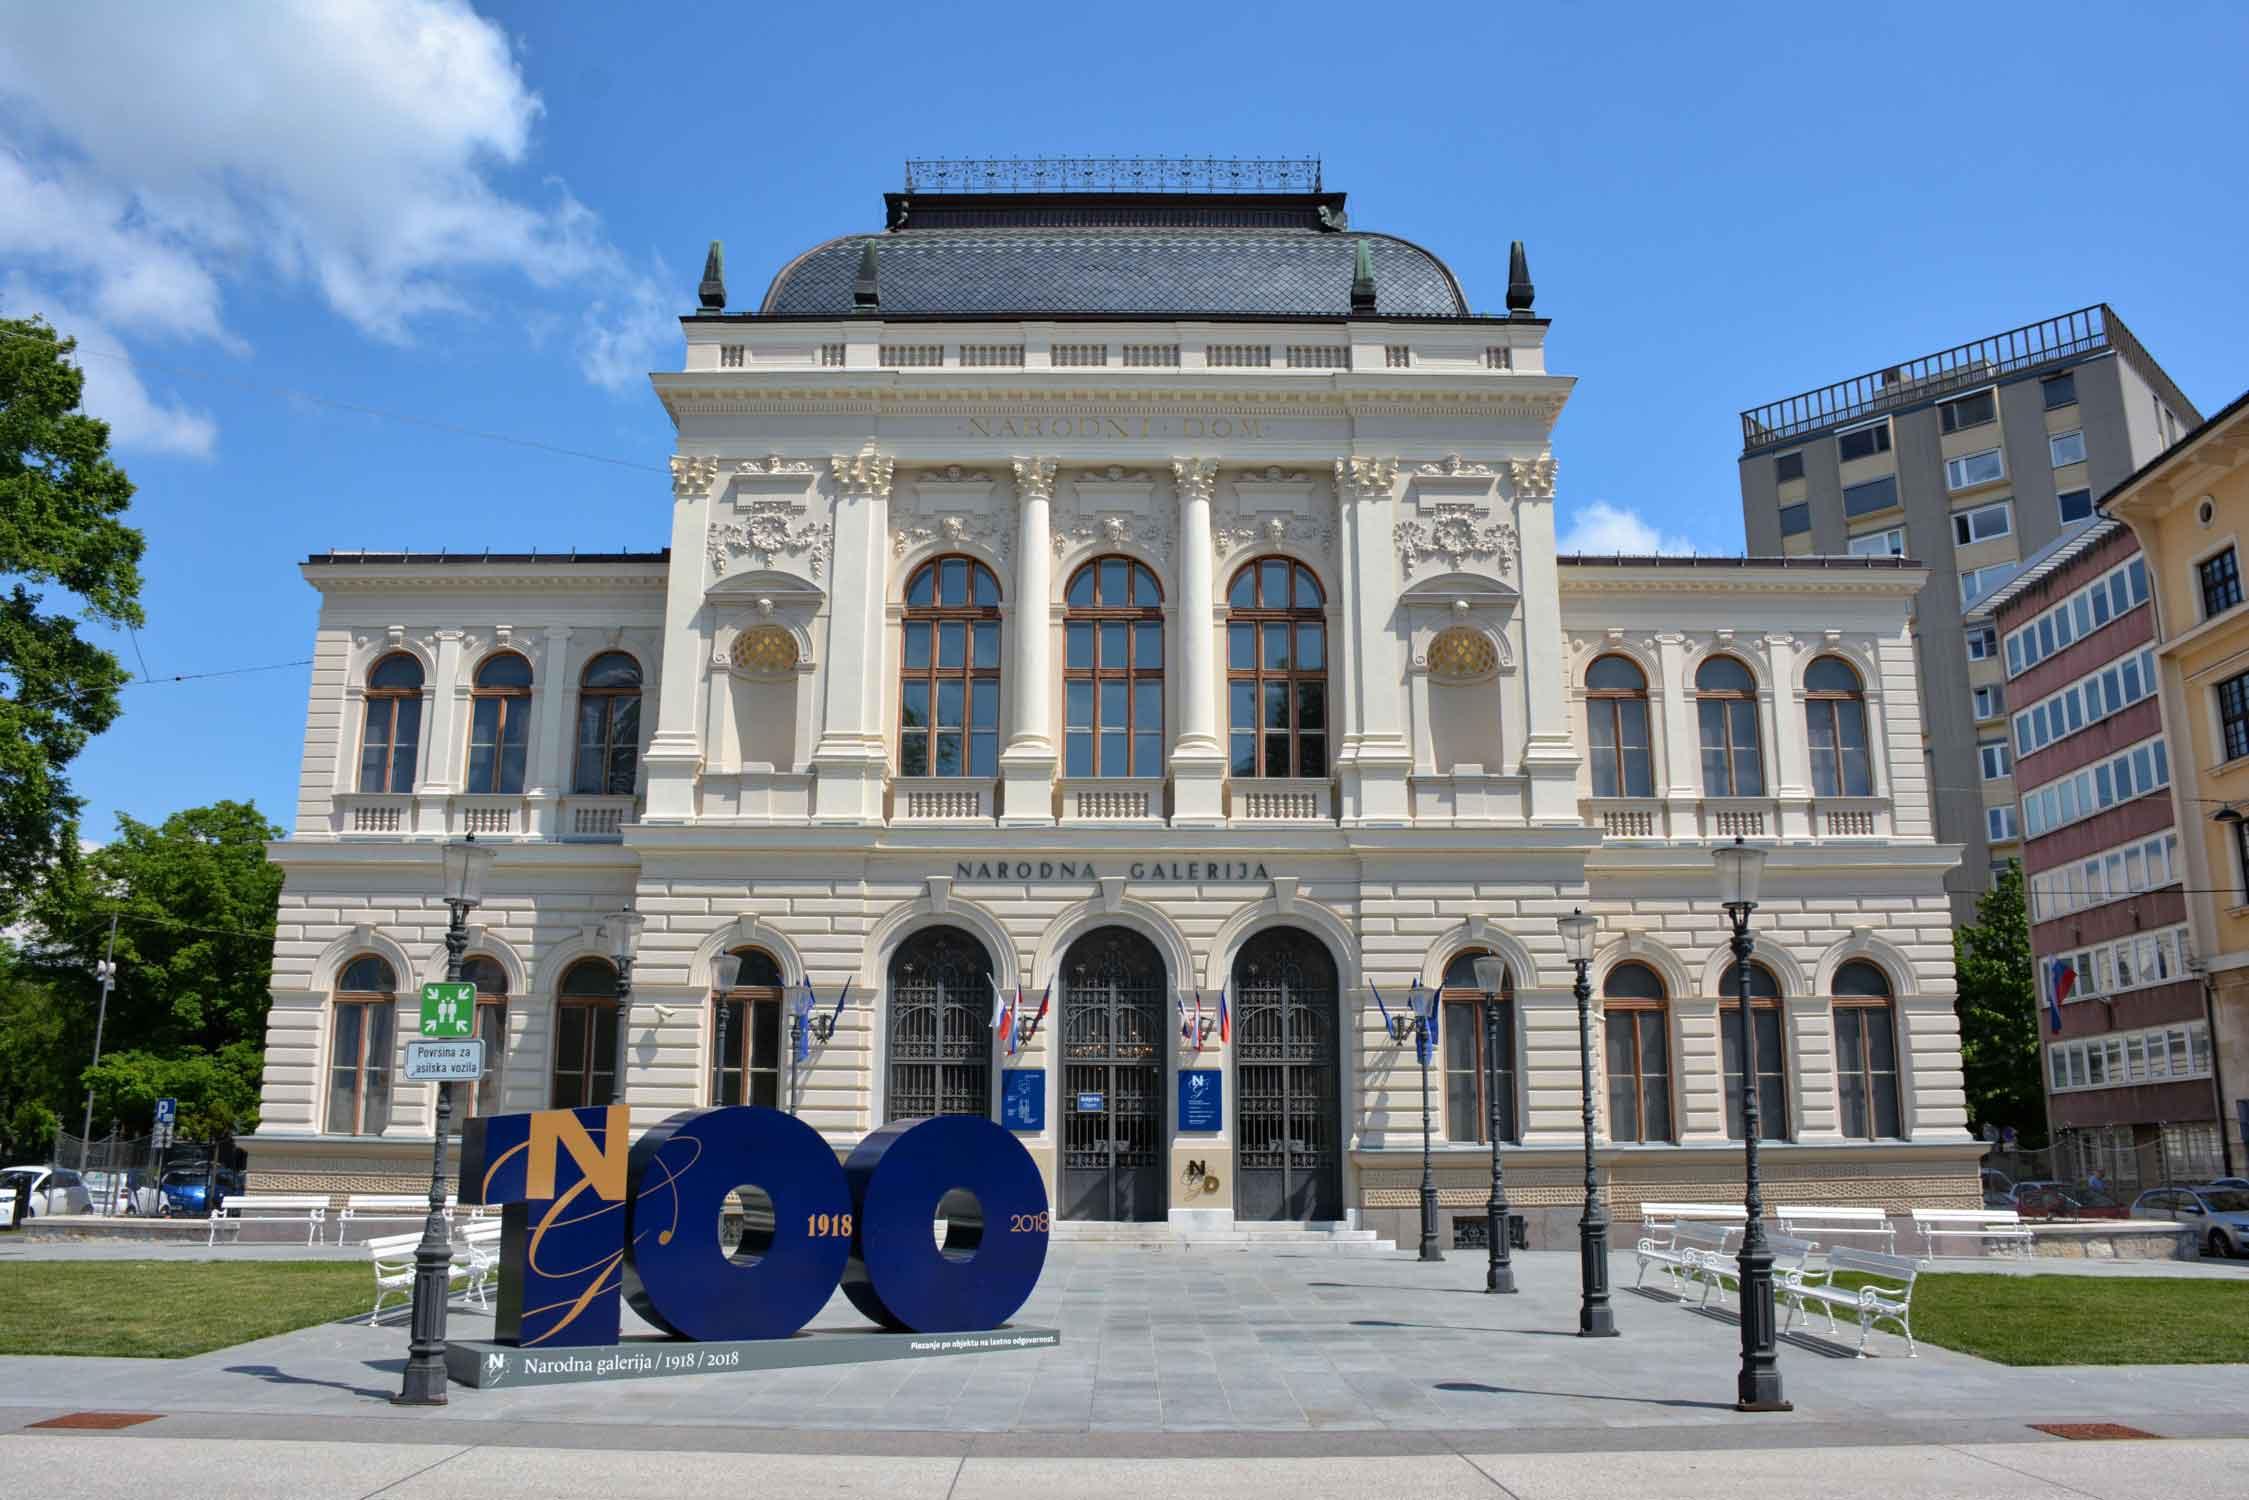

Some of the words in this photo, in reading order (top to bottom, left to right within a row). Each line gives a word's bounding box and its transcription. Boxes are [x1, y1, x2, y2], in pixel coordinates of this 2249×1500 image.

[967, 416, 1150, 438] NARODNI
[1182, 416, 1265, 438] DOM
[956, 862, 1096, 880] NARODNA
[1129, 862, 1269, 880] GALERIJA
[460, 1049, 471, 1057] za
[451, 1062, 477, 1073] vozila
[807, 1213, 853, 1237] 1918
[1010, 1210, 1050, 1232] 2018
[524, 1356, 593, 1374] Narodna
[596, 1354, 652, 1375] galerija
[655, 1351, 663, 1370] /
[665, 1353, 695, 1370] 1918
[697, 1351, 705, 1368] /
[707, 1351, 739, 1367] 2018
